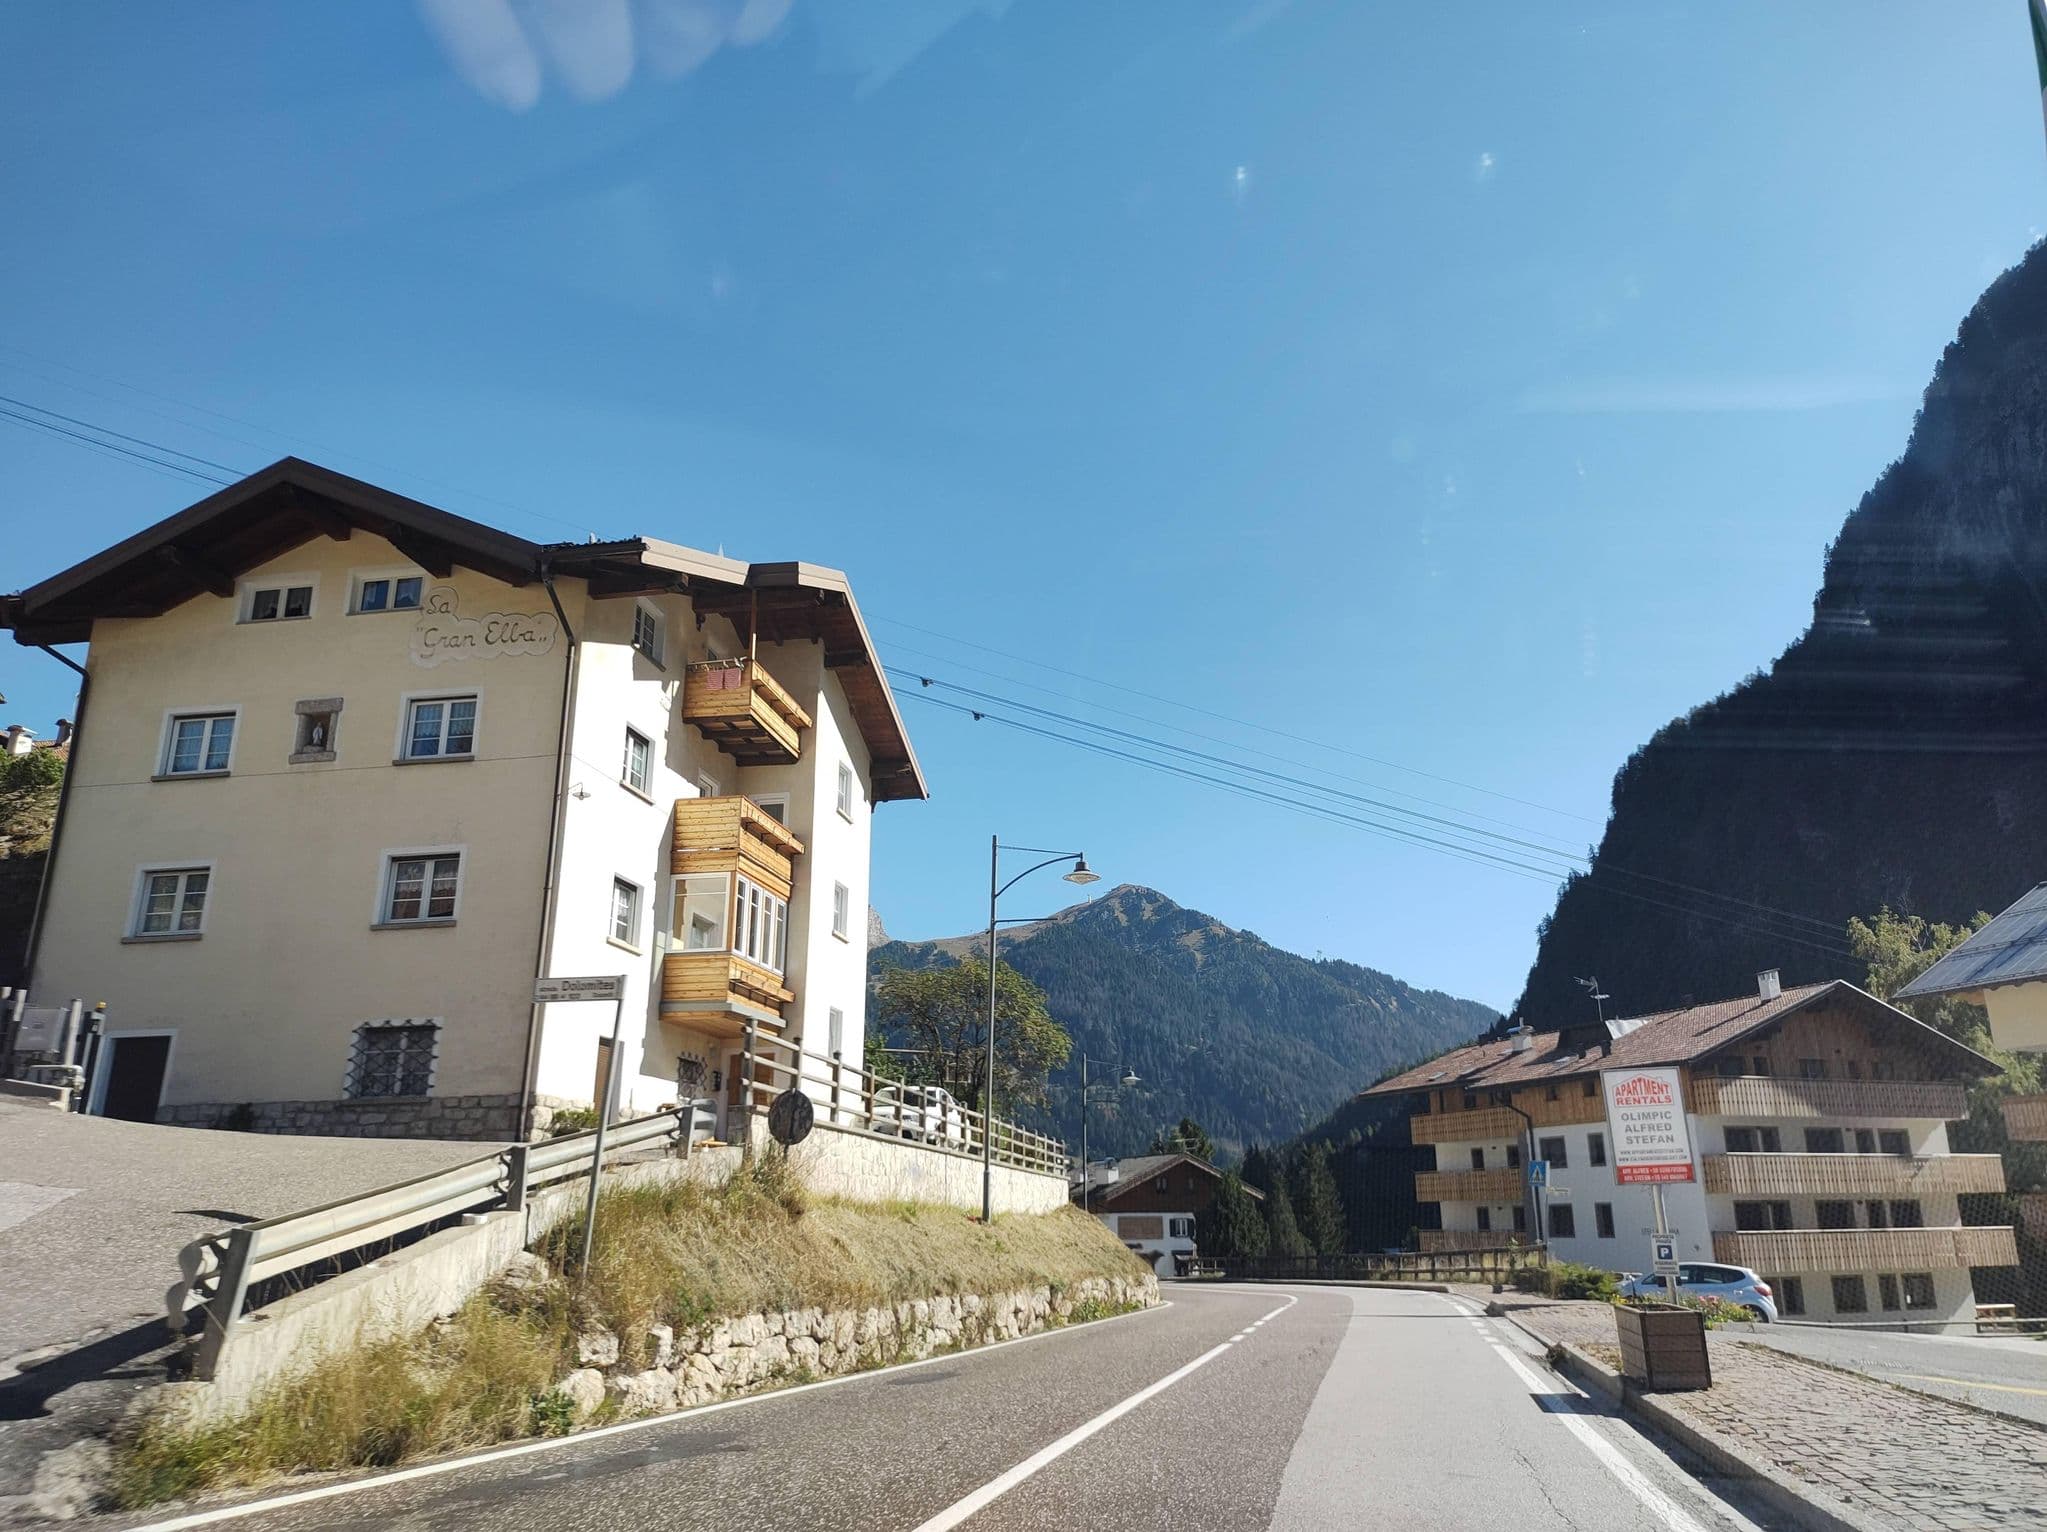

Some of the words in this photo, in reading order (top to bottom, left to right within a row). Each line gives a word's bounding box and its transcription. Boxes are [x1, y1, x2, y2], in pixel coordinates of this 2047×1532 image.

[1615, 1077, 1669, 1096] APARTMENT
[1616, 1094, 1672, 1105] RENTALS
[1621, 1111, 1672, 1121] OLIMPIC
[1625, 1122, 1672, 1133] ALFRED
[1626, 1134, 1674, 1145] STEFAN
[1660, 1247, 1669, 1258] P
